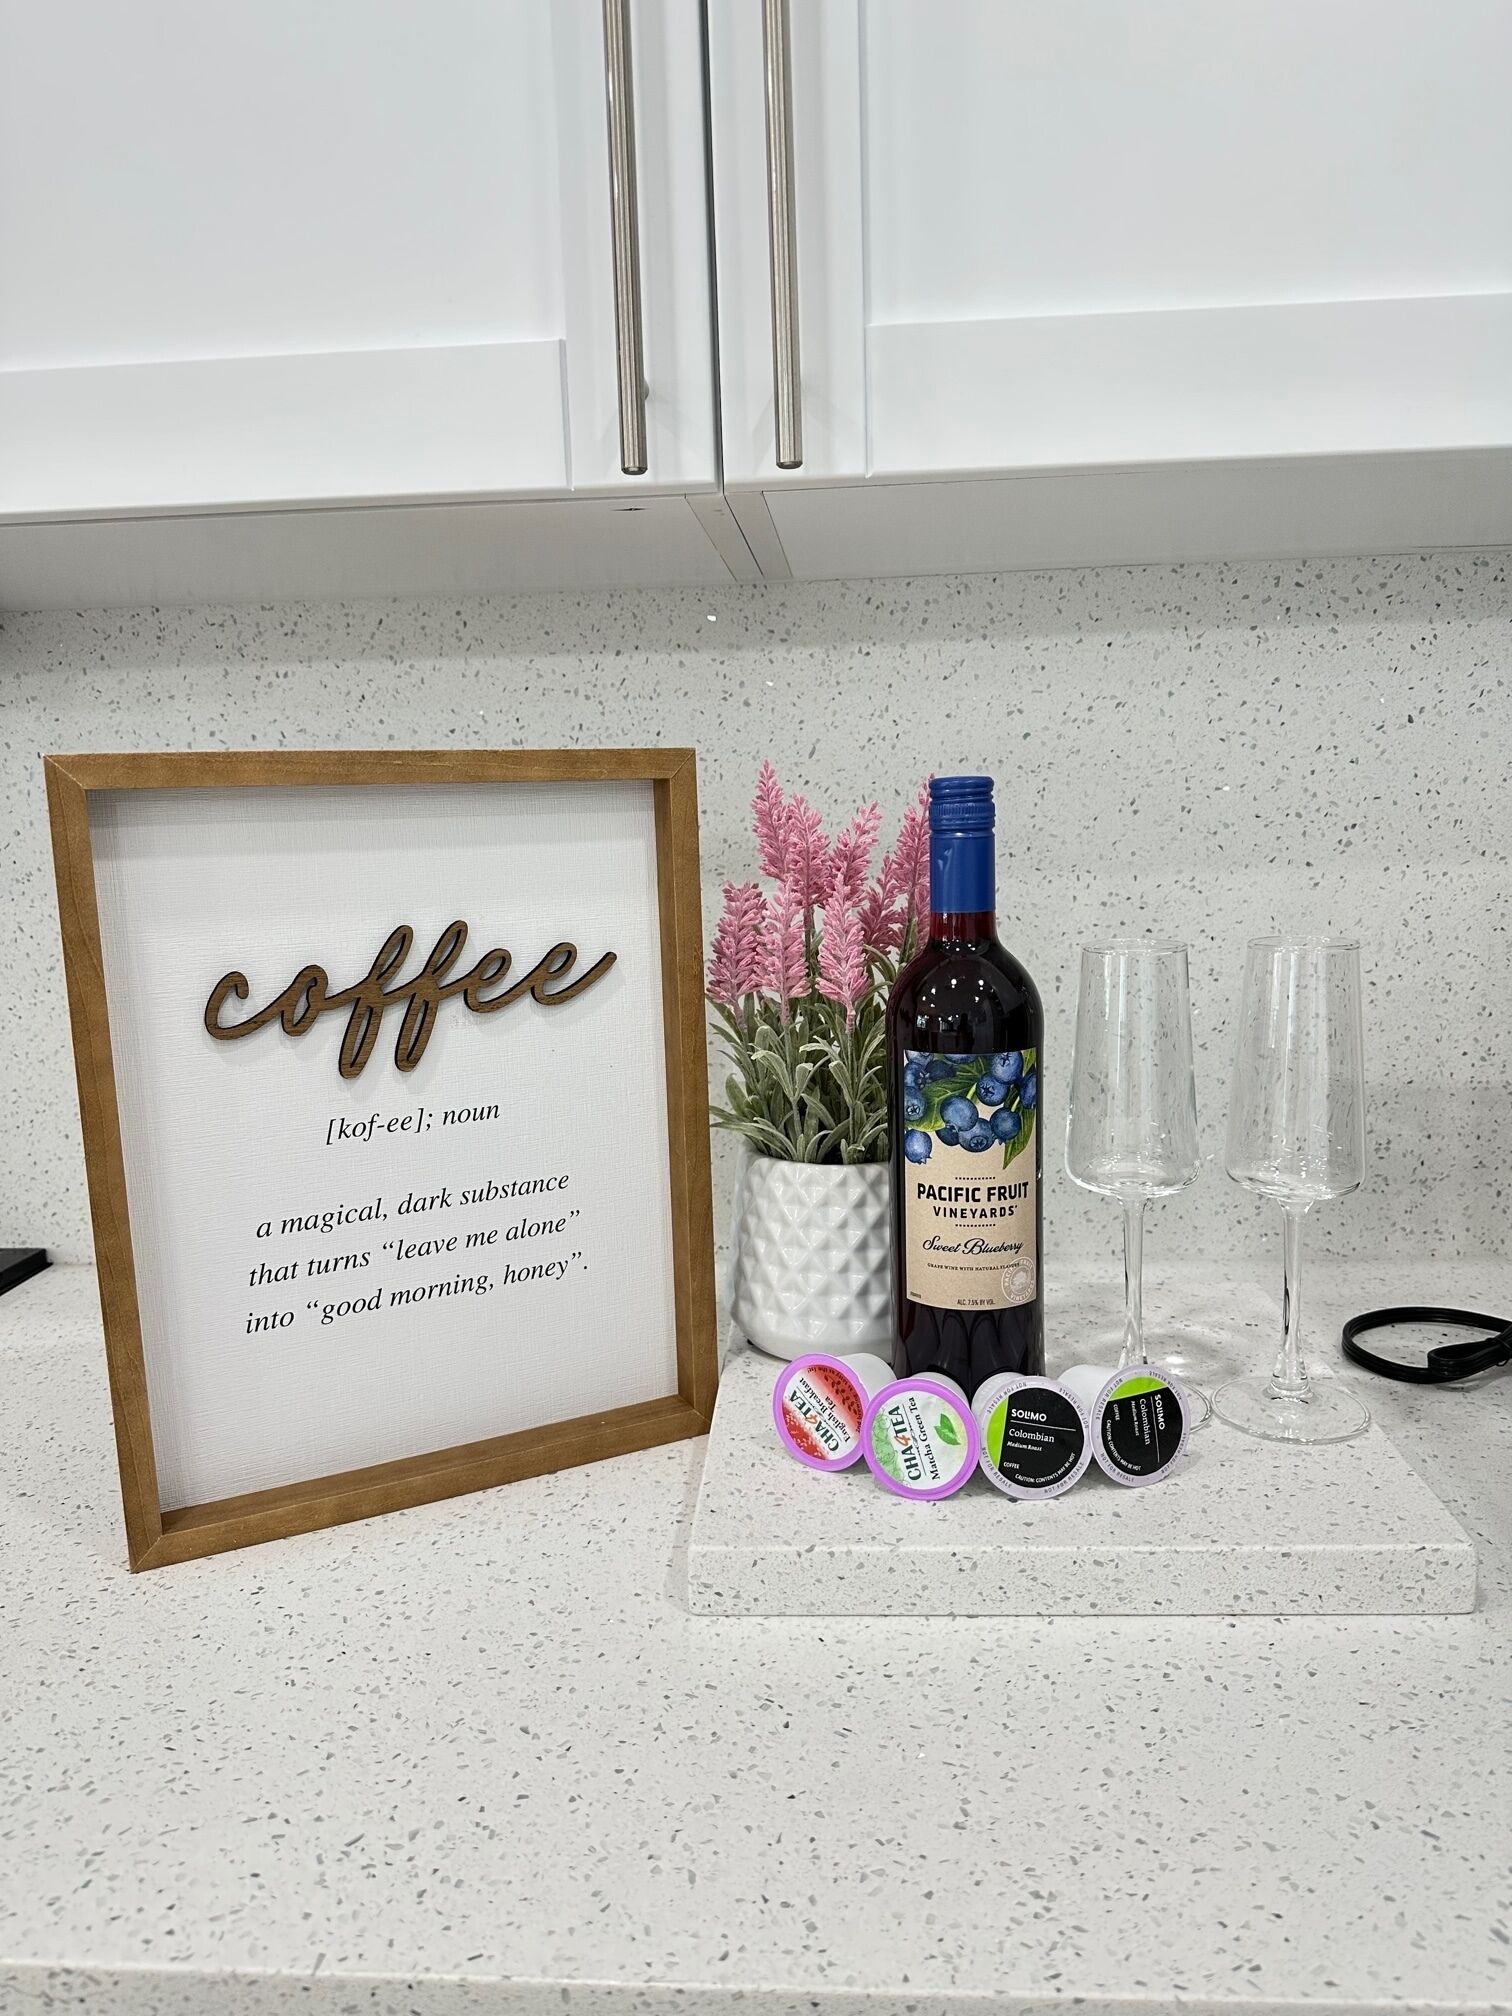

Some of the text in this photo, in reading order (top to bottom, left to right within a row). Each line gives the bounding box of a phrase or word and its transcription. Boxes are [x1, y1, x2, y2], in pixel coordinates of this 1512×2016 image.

[204, 920, 617, 1079] coffee
[326, 1104, 500, 1145] [kof-ee]; noun
[256, 1173, 570, 1238] a magical, dark substance
[917, 1181, 1029, 1202] PACIFIC FRUIT
[933, 1205, 1014, 1219] VINEYARDS
[249, 1210, 581, 1286] that turns “leave me alone”
[922, 1235, 1024, 1255] Sweet Blueberry
[245, 1251, 588, 1334] into “good morning, honey”.
[800, 1376, 851, 1443] English Breakfast
[825, 1396, 837, 1412] Tea
[1011, 1408, 1047, 1422] SOLIMO
[1140, 1398, 1151, 1445] Colombian
[1154, 1394, 1165, 1430] SOLIMO
[908, 1397, 940, 1480] Matcha Green Tea
[1008, 1428, 1055, 1443] Colombian
[1003, 1461, 1020, 1469] COFFEE
[1035, 1472, 1058, 1483] CONTENTS
